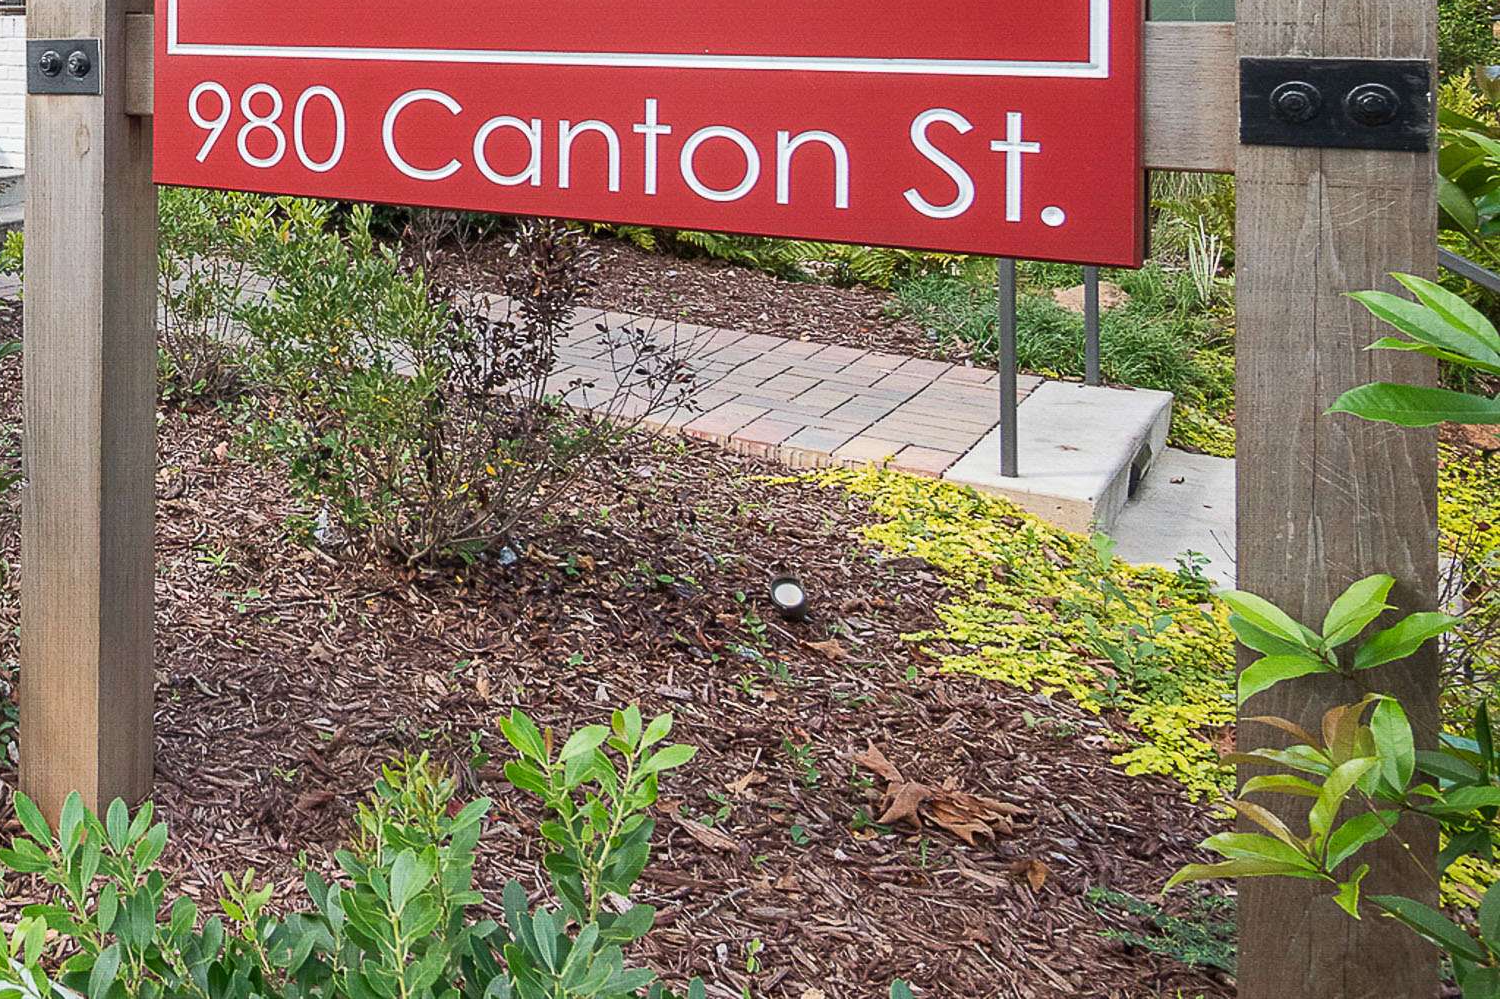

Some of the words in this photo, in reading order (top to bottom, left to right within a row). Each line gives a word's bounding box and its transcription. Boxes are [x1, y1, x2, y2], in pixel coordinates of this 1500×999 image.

[187, 81, 346, 172] 980
[382, 89, 850, 209] Canton
[903, 108, 1066, 229] St.
